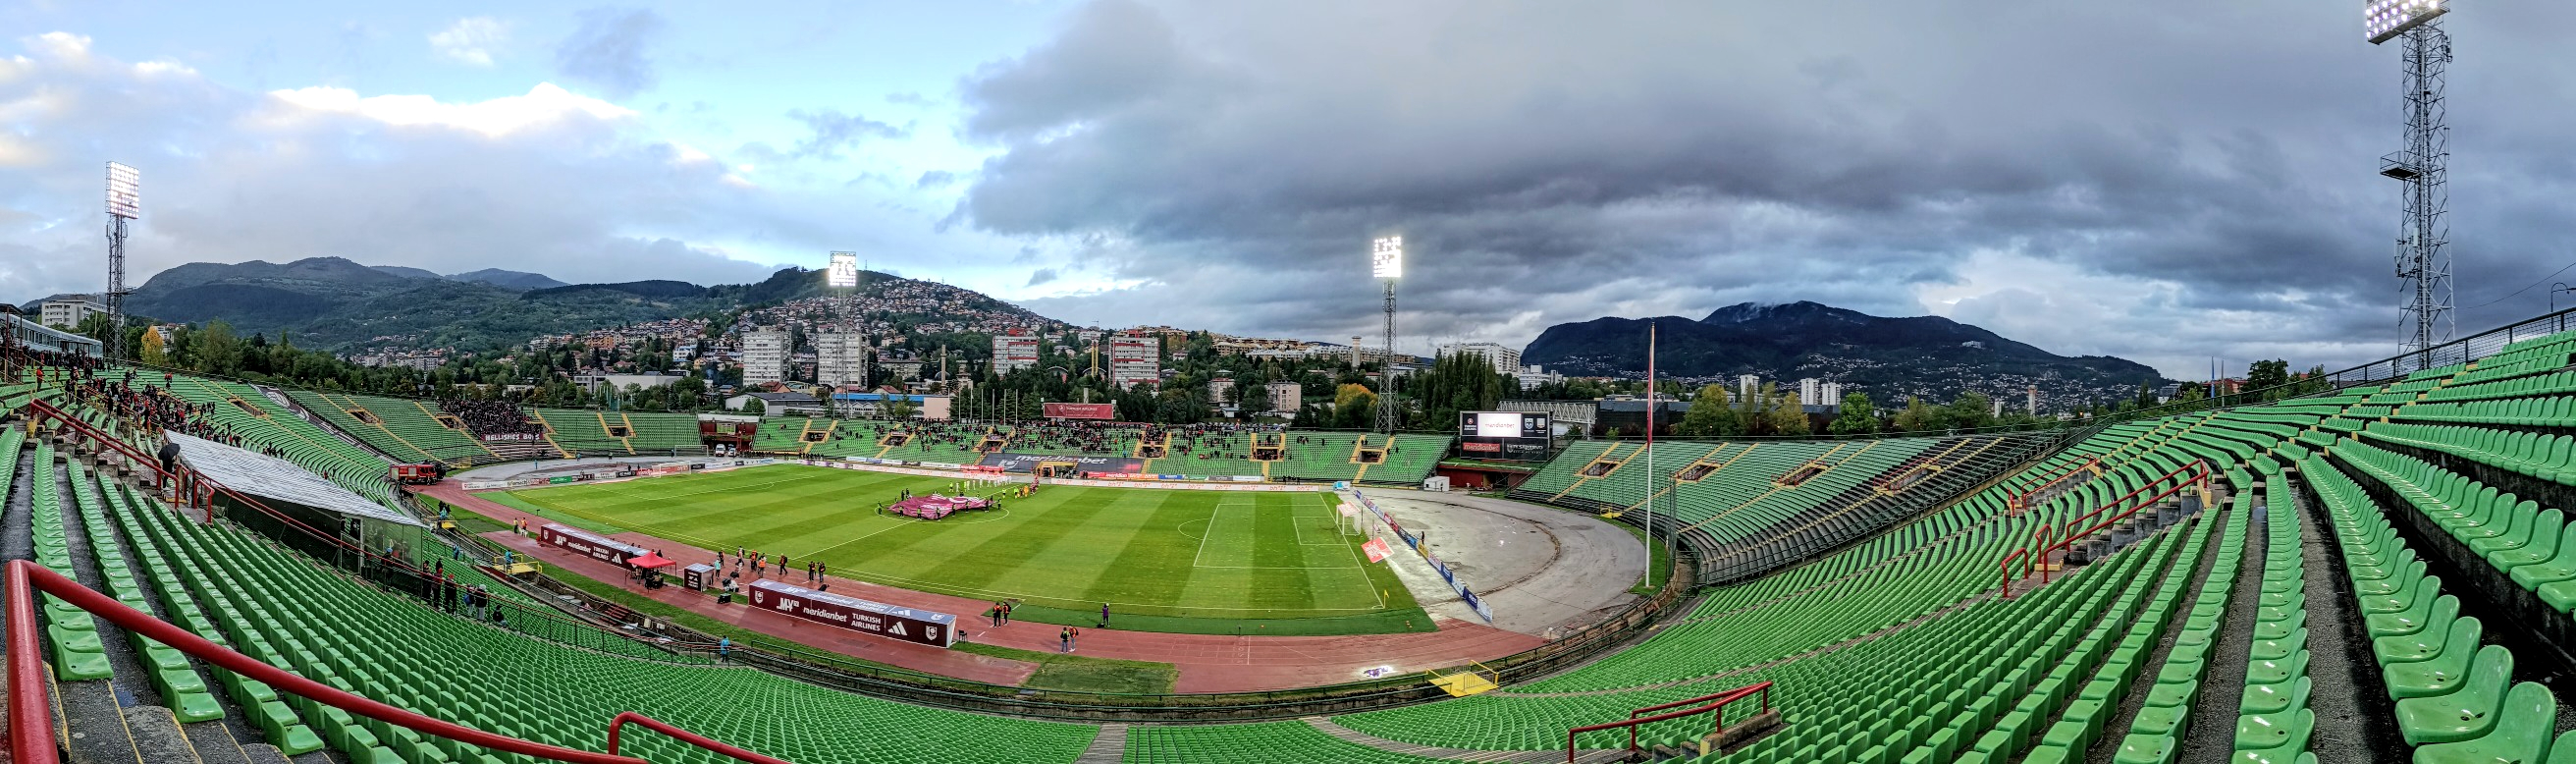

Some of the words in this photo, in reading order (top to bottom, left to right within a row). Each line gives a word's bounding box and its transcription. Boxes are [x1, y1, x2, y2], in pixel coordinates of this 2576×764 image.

[1015, 455, 1107, 464] meridianbet
[803, 606, 847, 622] meridianbet
[851, 613, 882, 625] TURKISH
[850, 620, 882, 631] AIRLINES
